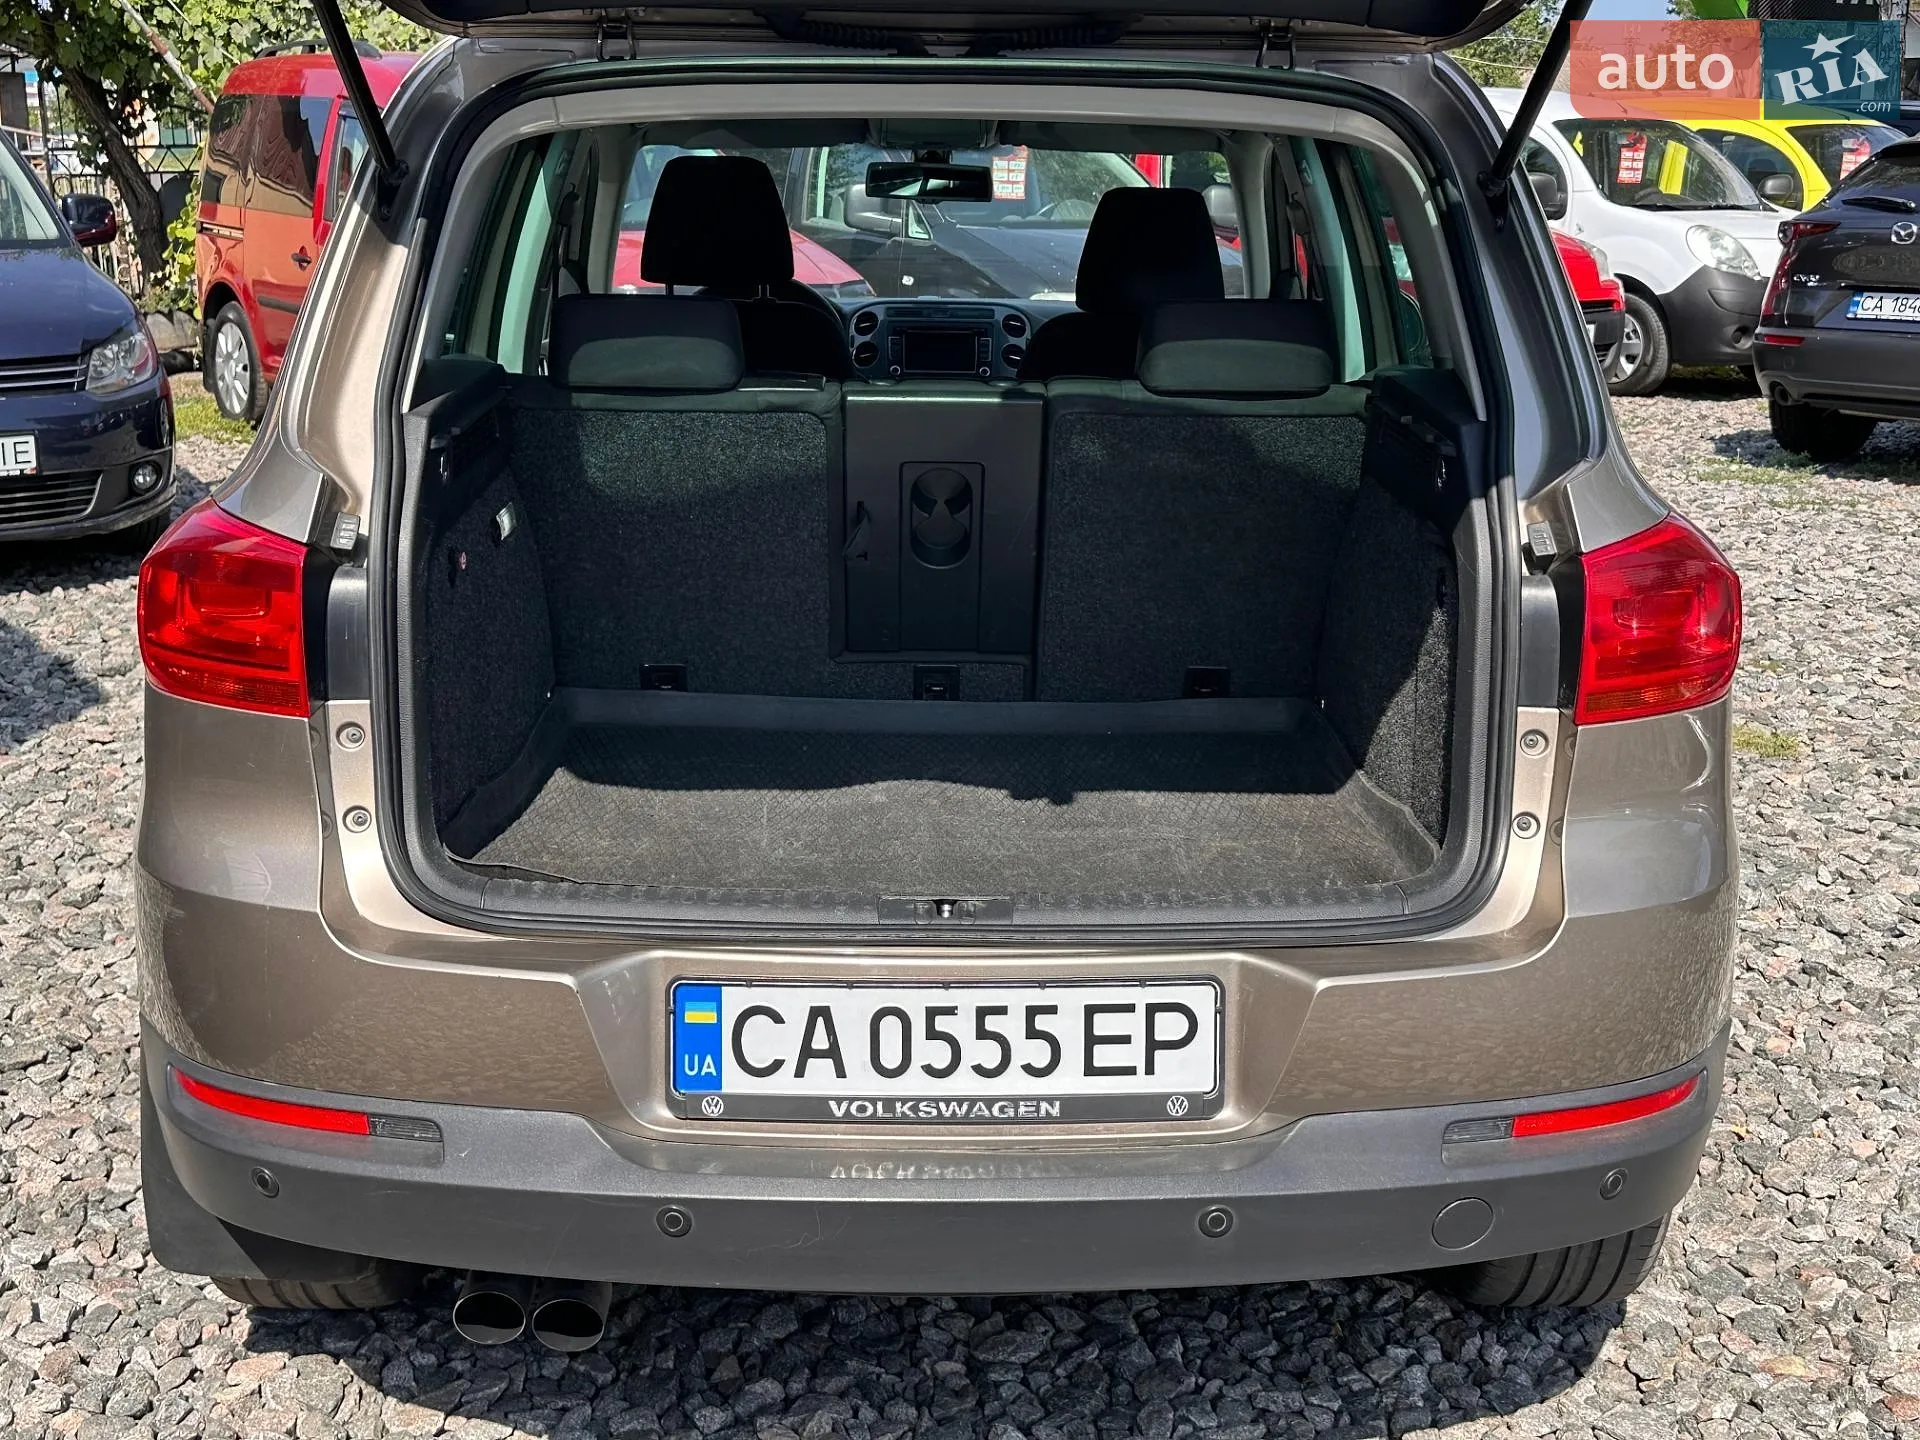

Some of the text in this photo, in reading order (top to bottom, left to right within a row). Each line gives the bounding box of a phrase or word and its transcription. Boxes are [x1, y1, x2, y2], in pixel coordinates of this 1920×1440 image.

[1861, 295, 1884, 312] CA
[731, 1002, 1199, 1079] CA 0555 EP
[684, 1053, 717, 1077] UA
[828, 1100, 1060, 1118] VOLKSWAGEN
